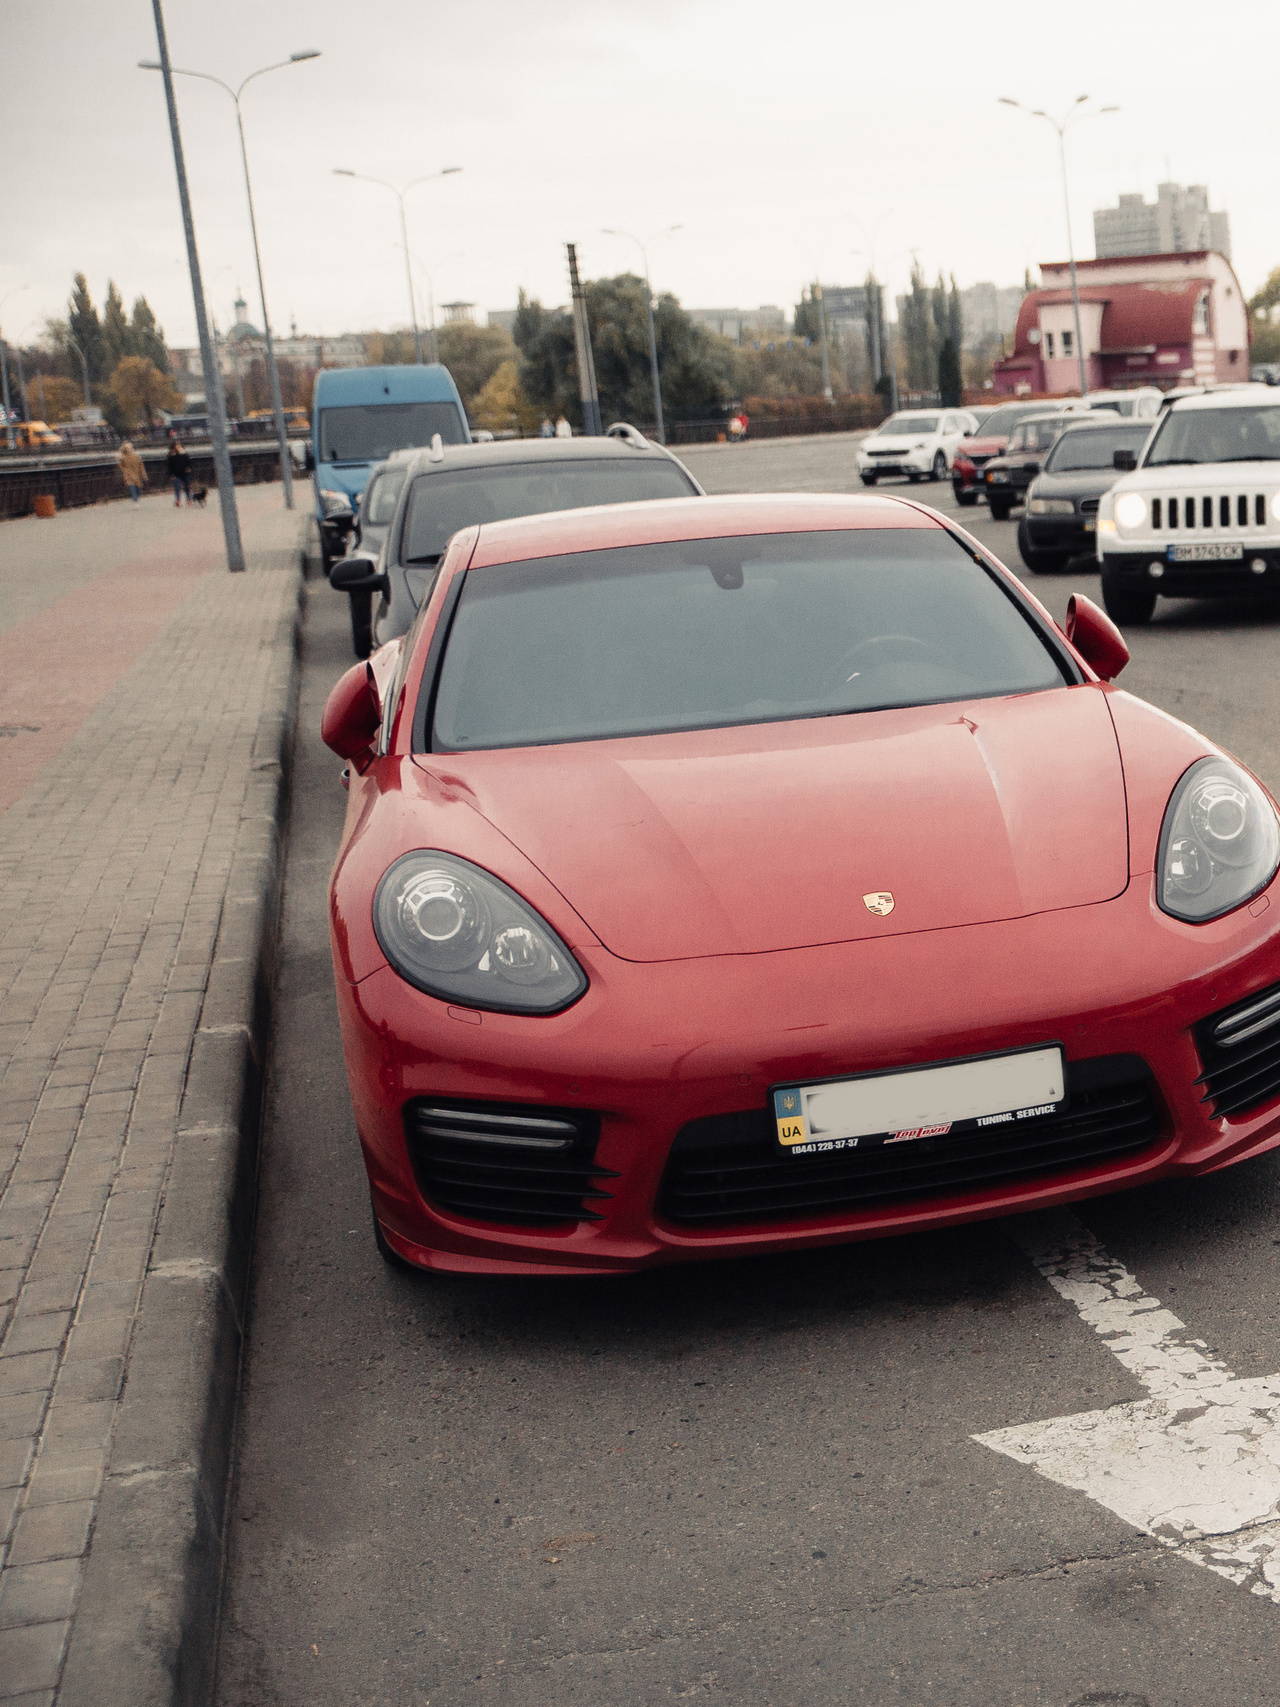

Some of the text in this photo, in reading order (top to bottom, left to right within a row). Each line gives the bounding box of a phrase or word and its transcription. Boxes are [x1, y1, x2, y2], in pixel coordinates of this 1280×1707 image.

[1016, 1104, 1056, 1119] SERVICE
[782, 1126, 801, 1138] UA
[792, 1138, 859, 1154] (044) 228-37-37
